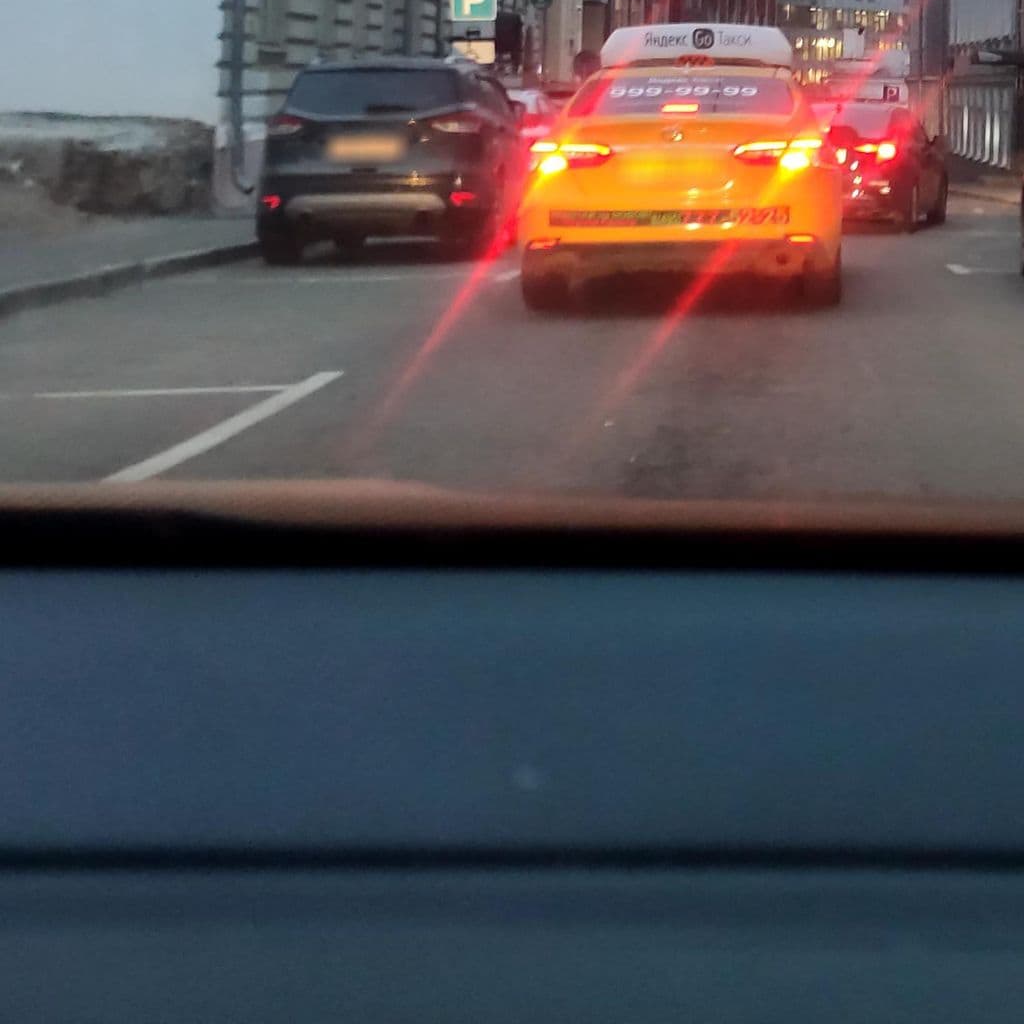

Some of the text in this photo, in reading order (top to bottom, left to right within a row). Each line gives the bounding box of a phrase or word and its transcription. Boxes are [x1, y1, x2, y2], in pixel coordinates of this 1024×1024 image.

[643, 31, 690, 48] Яндекс
[717, 31, 752, 47] Такси
[609, 85, 758, 97] 999-99-99
